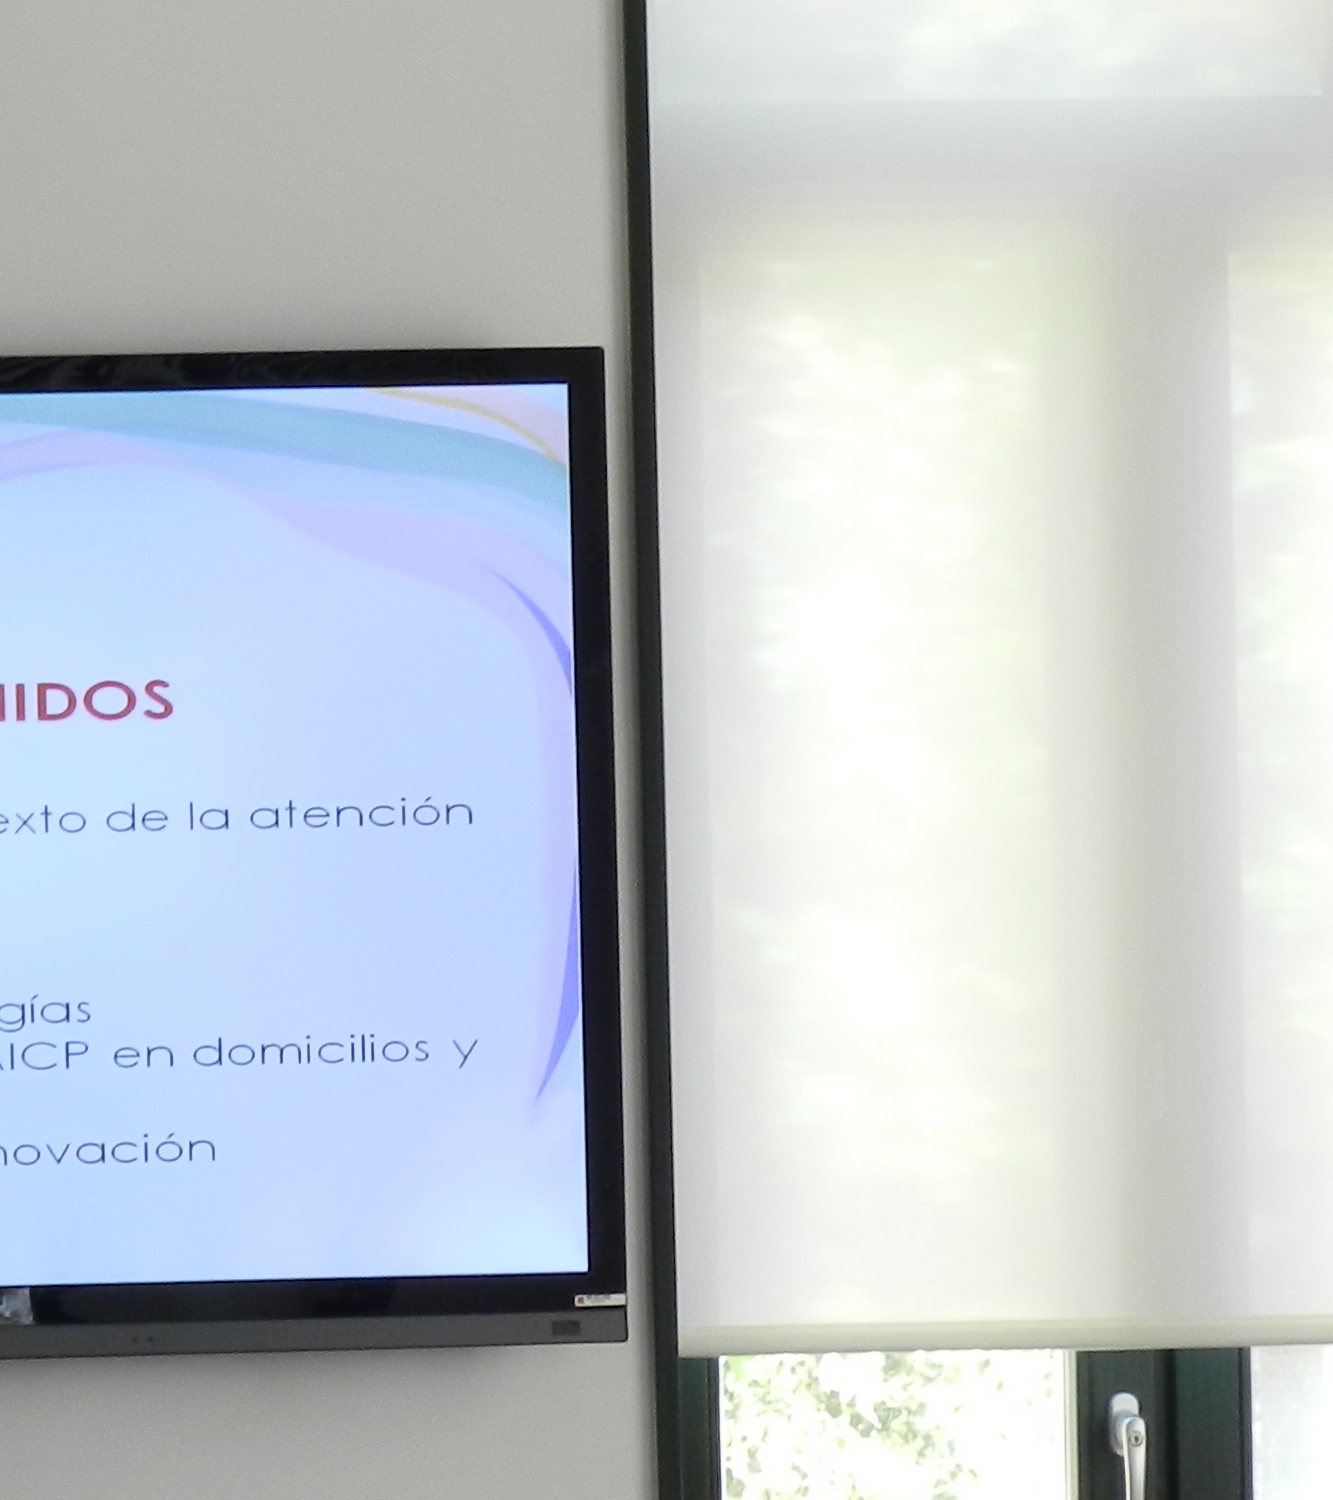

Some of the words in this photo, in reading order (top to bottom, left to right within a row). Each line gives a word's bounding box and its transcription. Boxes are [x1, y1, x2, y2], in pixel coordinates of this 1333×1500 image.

[106, 803, 168, 832] de
[190, 802, 229, 830] la
[250, 796, 473, 829] atención
[114, 1046, 174, 1068] en
[193, 1034, 429, 1066] domicilios
[453, 1039, 478, 1069] y
